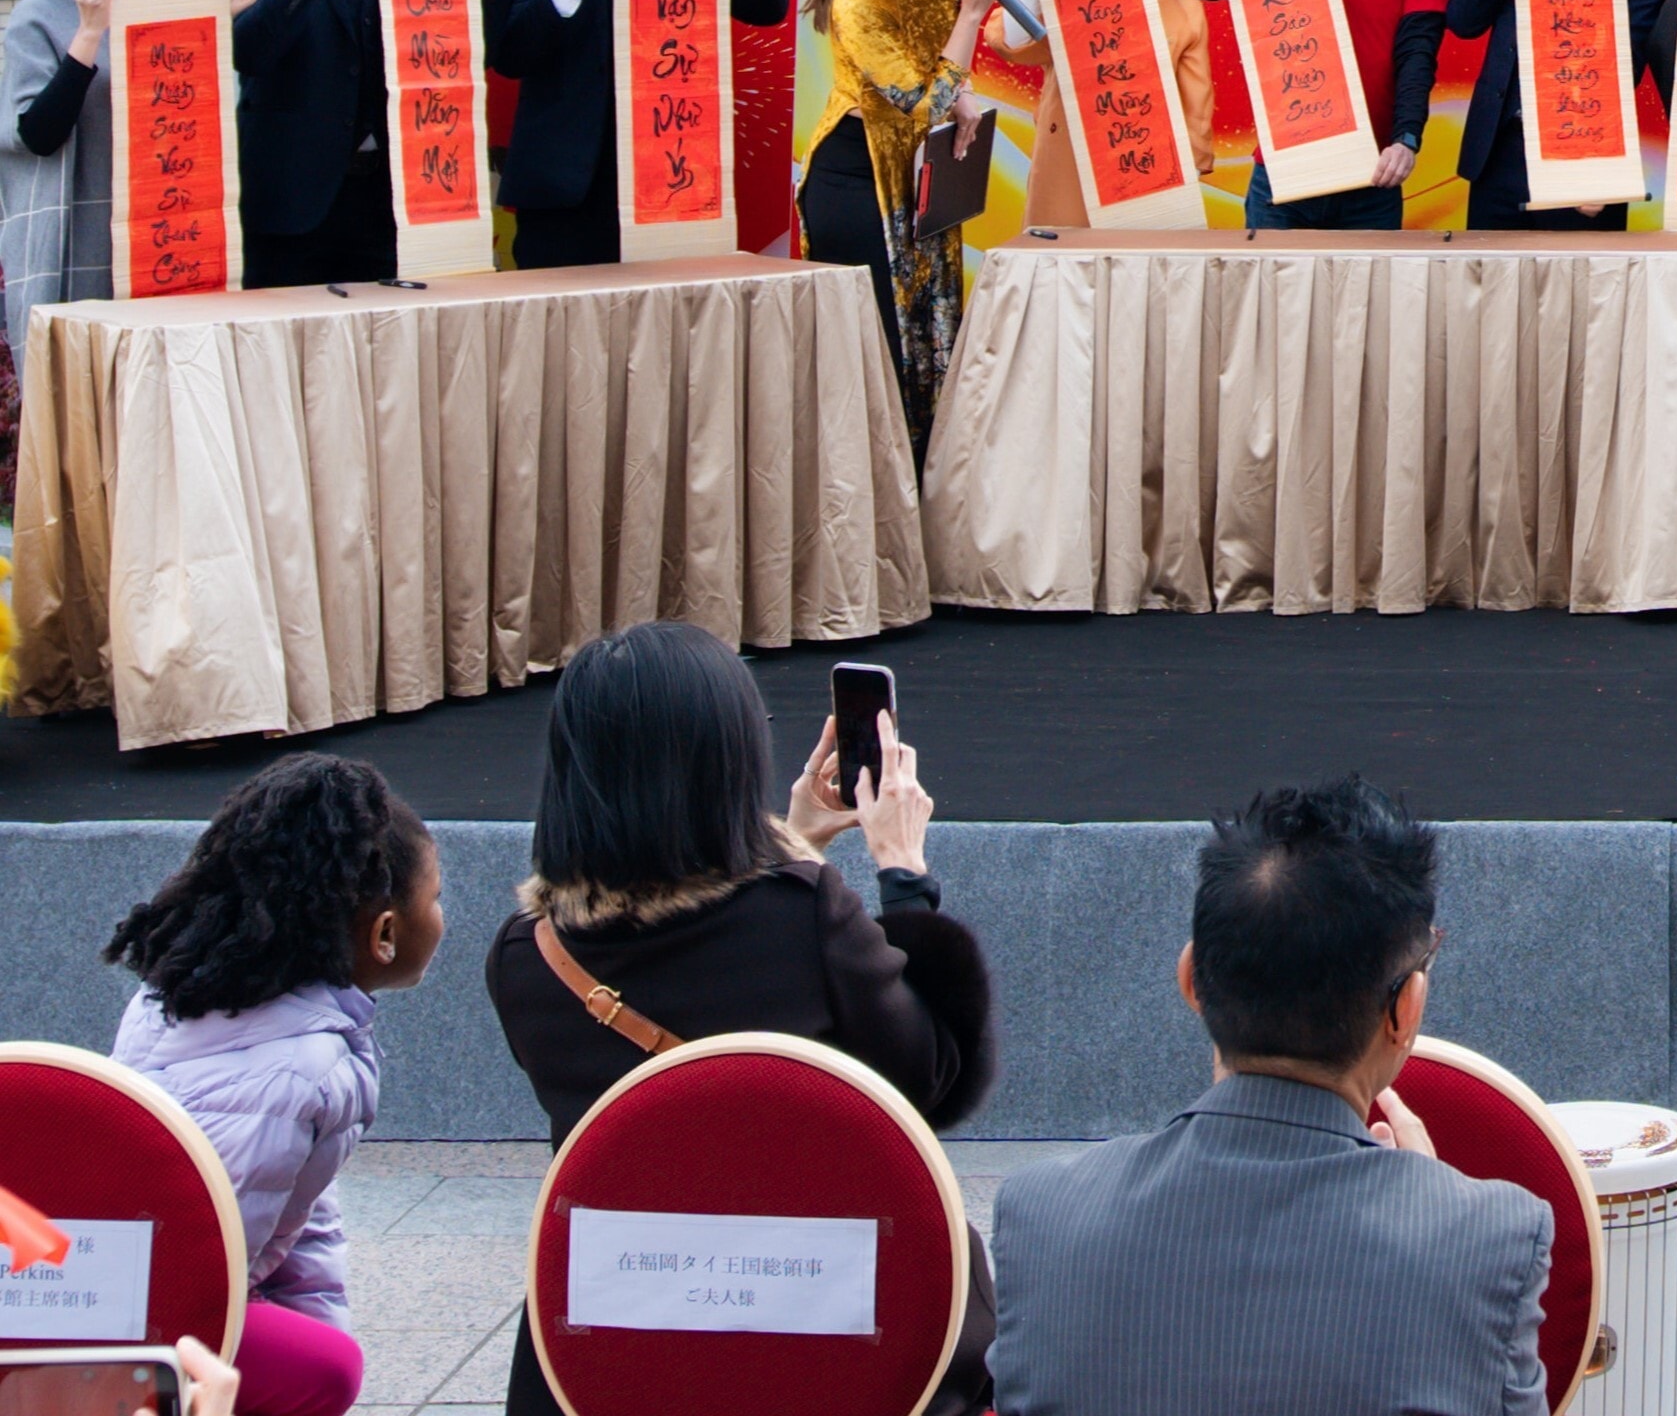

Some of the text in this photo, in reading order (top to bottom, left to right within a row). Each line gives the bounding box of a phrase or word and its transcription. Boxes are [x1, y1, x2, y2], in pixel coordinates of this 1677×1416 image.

[617, 1251, 824, 1279] 在福岡タイ王国総領事
[685, 1287, 756, 1308] ご夫人様
